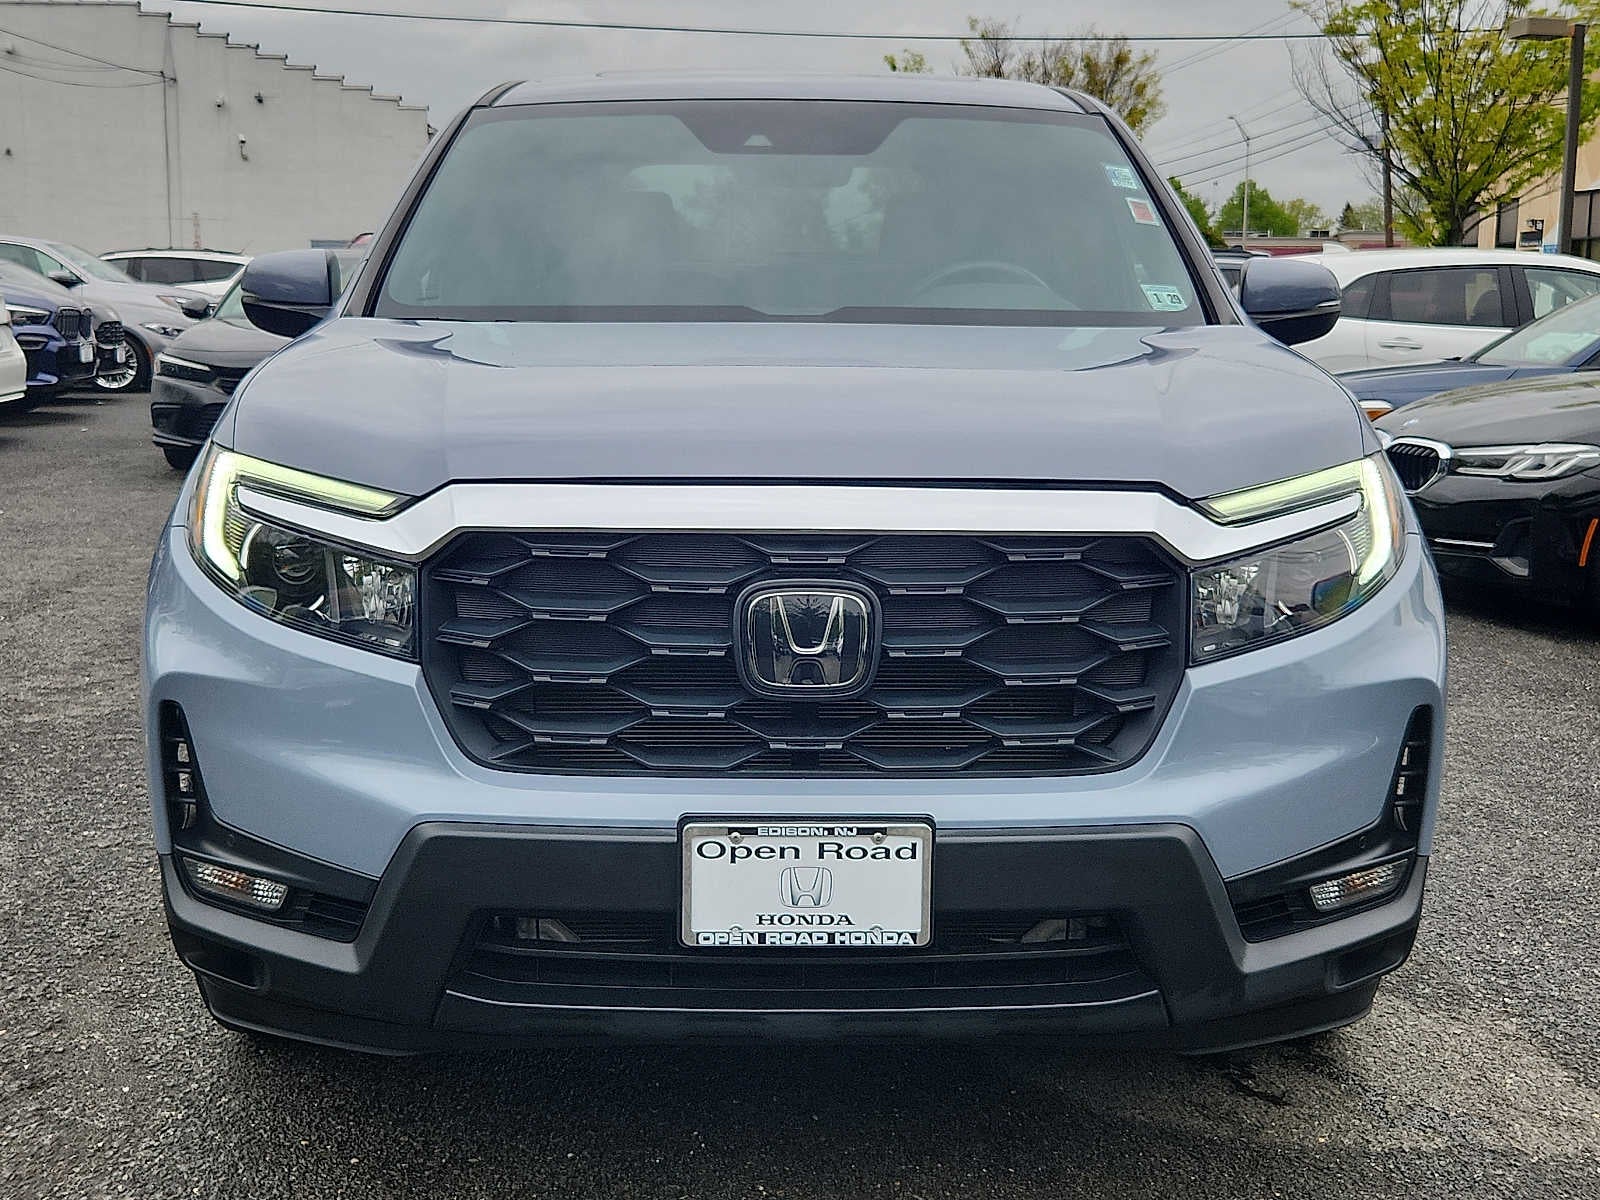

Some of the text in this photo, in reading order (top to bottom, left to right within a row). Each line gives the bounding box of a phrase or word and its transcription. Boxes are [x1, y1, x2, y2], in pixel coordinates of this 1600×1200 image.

[834, 827, 858, 836] NJ
[696, 840, 918, 864] Open Road
[756, 914, 856, 926] HONDA
[698, 932, 916, 945] OPEN ROAD HONDA
